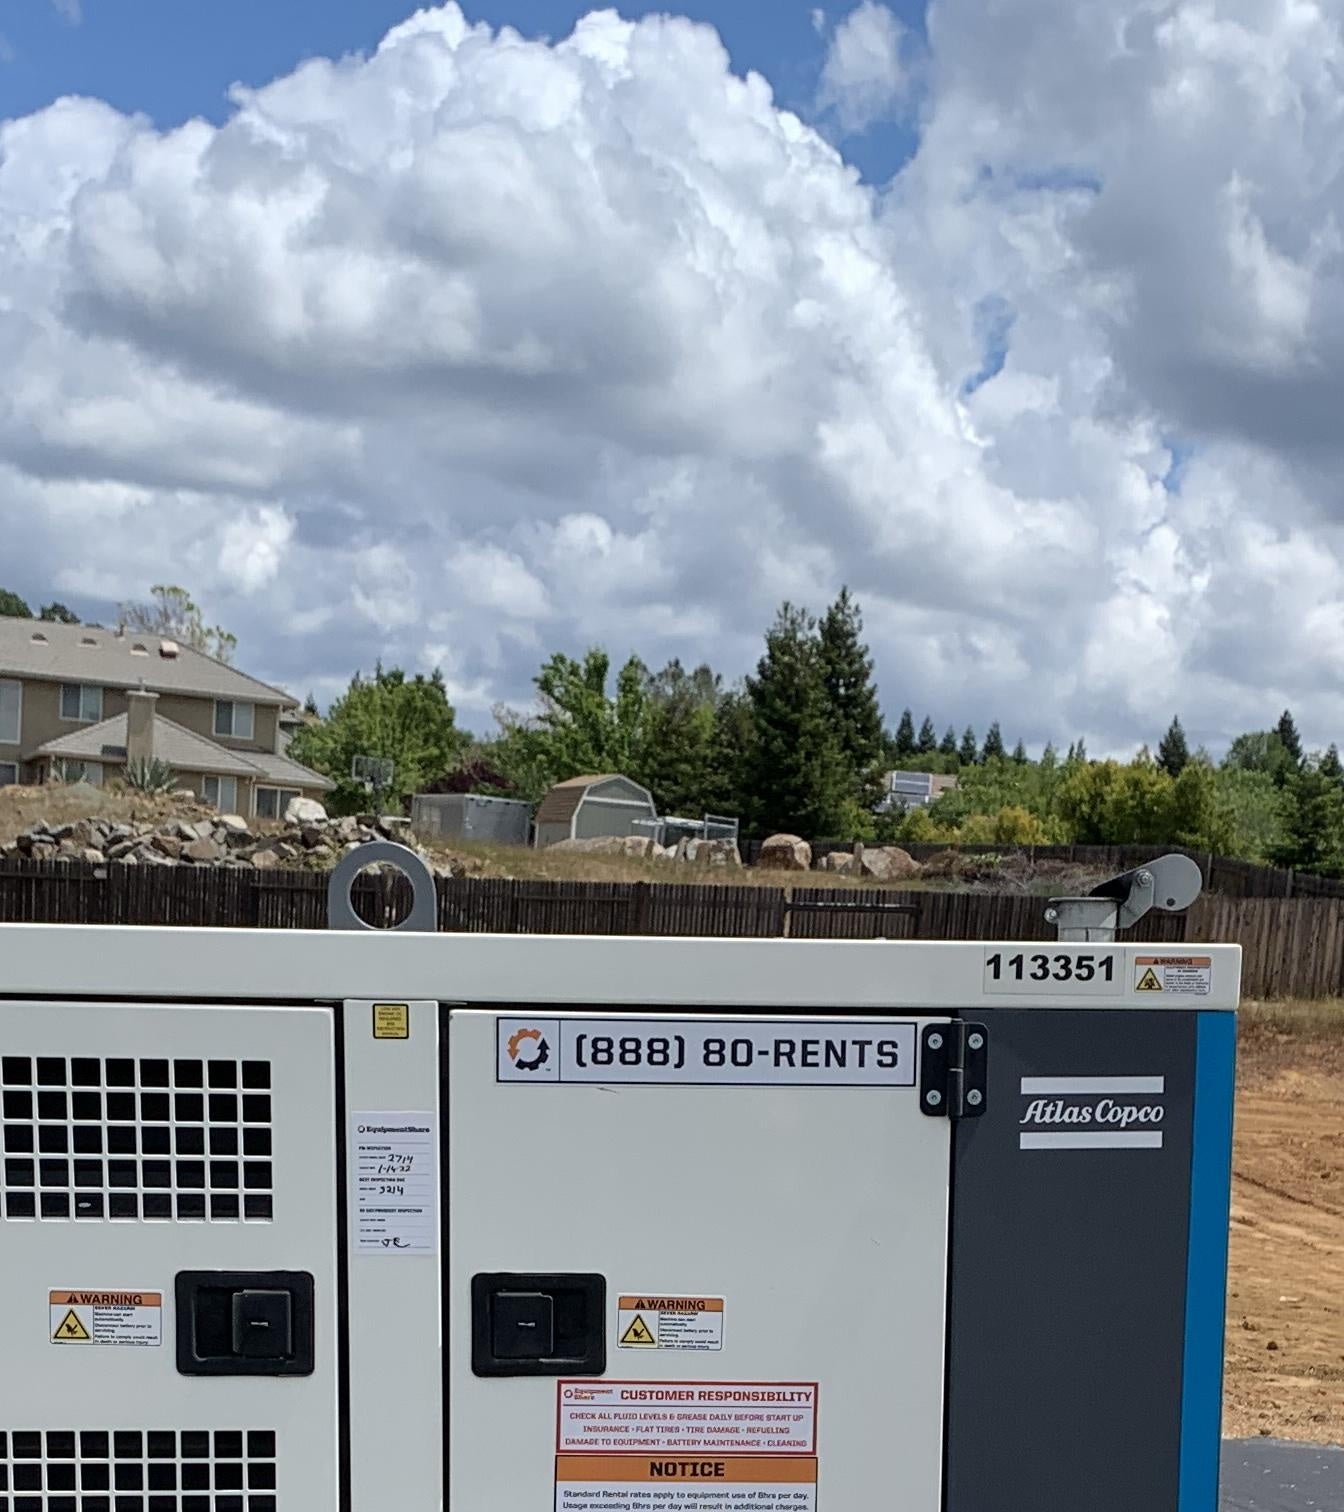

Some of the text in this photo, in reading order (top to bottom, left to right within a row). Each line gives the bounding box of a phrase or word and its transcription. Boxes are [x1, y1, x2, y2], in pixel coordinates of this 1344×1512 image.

[986, 953, 1114, 981] 113351
[575, 1034, 900, 1069] (888) 80-RENTS
[1019, 1100, 1165, 1128] Atlas Copco
[80, 1294, 143, 1305] WARNING
[647, 1300, 706, 1310] WARNING
[620, 1390, 813, 1402] CUSTOMER RESPONSIBILITY
[569, 1412, 596, 1420] CHECK
[598, 1412, 612, 1420] ALL
[613, 1412, 637, 1420] FLUID
[676, 1413, 707, 1421] GREASE
[709, 1413, 732, 1421] DAILY
[734, 1413, 764, 1421] BEFORE
[766, 1414, 791, 1422] START
[792, 1414, 804, 1422] UP
[583, 1425, 630, 1433] INSURANCE
[636, 1425, 654, 1433] FLAT
[656, 1425, 680, 1433] TIRES
[706, 1426, 740, 1434] DAMAGE
[746, 1426, 790, 1434] REFUELING
[565, 1438, 808, 1447] DAMAGE TO EQUIPMENT BATTERY MAINTENANCE CLEANING
[649, 1462, 725, 1477] NOTICE
[563, 1490, 601, 1498] Standard
[653, 1491, 675, 1500] apply
[687, 1492, 729, 1500] equipment
[562, 1502, 588, 1510] Usage
[589, 1502, 631, 1511] exceeding
[652, 1503, 667, 1511] per
[668, 1502, 683, 1511] day
[733, 1503, 774, 1511] additional
